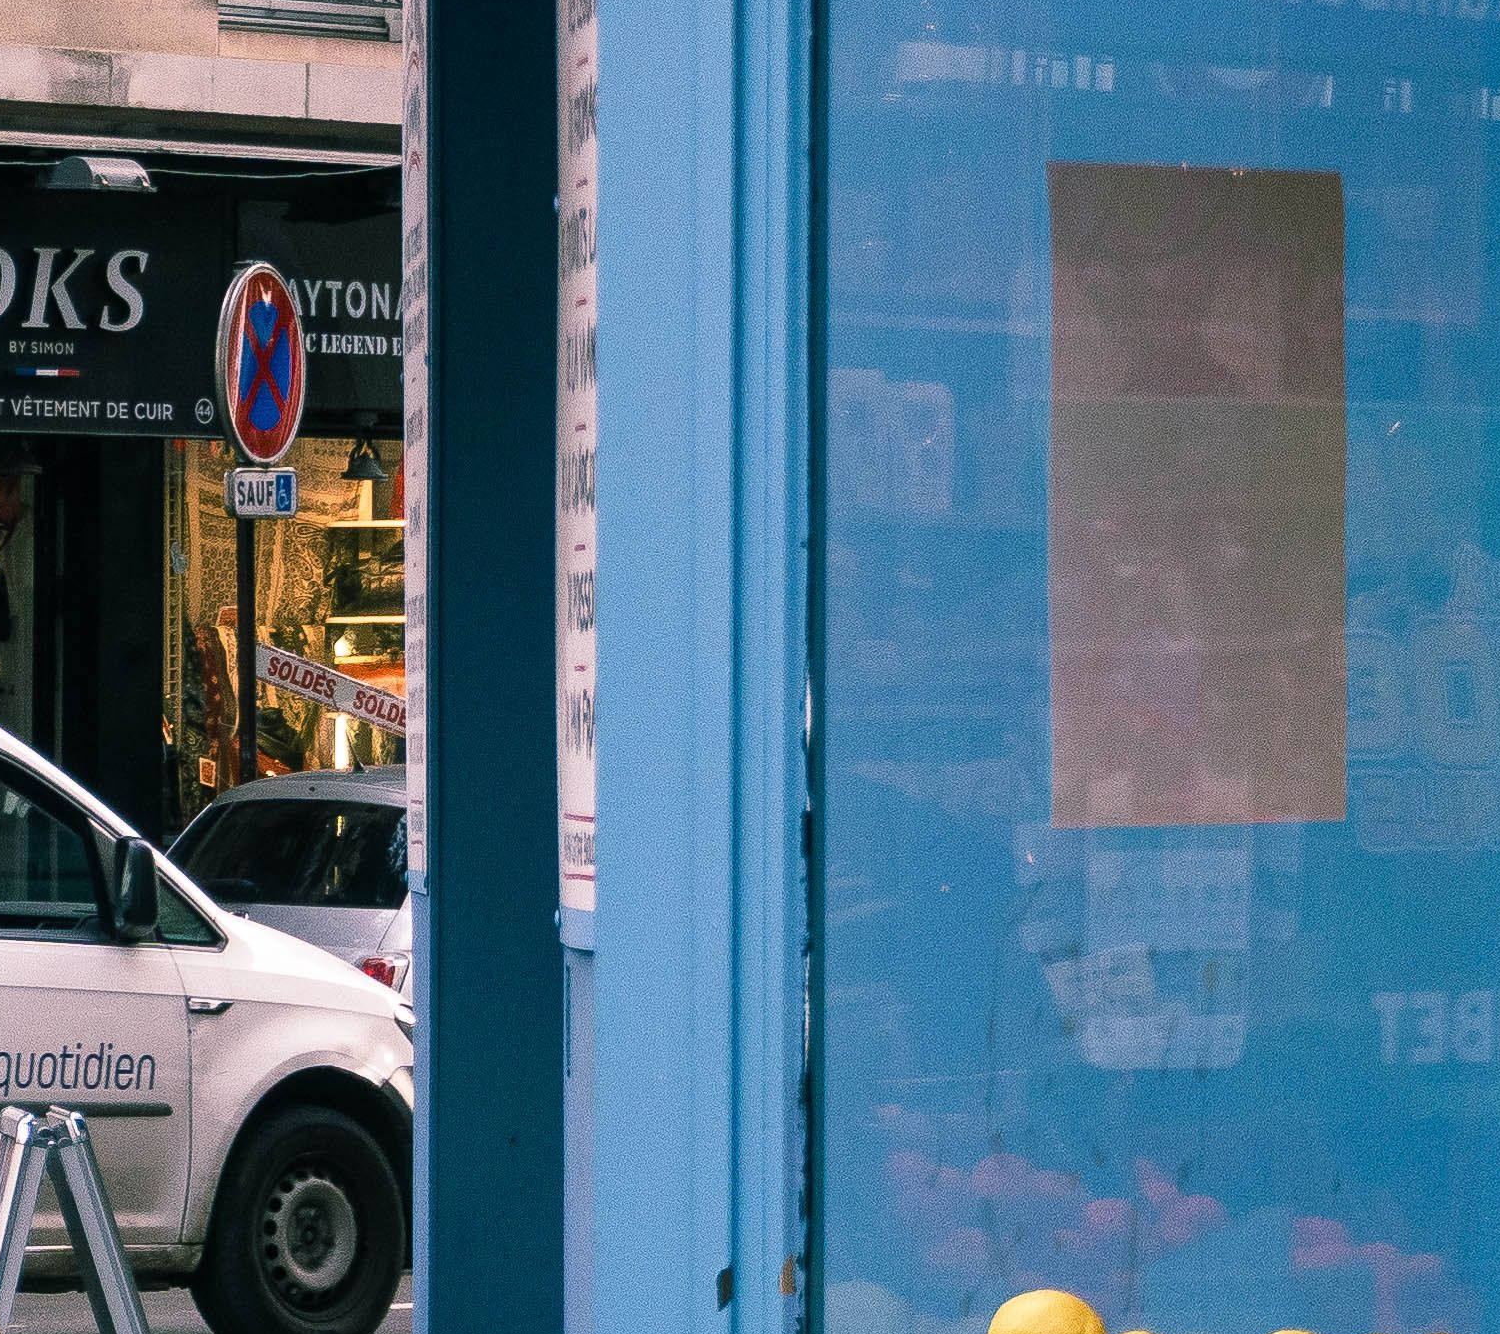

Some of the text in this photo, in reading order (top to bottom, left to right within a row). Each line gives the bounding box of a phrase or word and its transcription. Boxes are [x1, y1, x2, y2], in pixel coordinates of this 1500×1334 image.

[8, 340, 76, 356] BY SIMON
[320, 334, 388, 356] LEGEND
[11, 394, 101, 419] VÊTEMENT
[105, 401, 130, 420] DE
[133, 402, 174, 421] CUIR
[236, 480, 275, 507] SAUF
[266, 656, 337, 699] SOLDES
